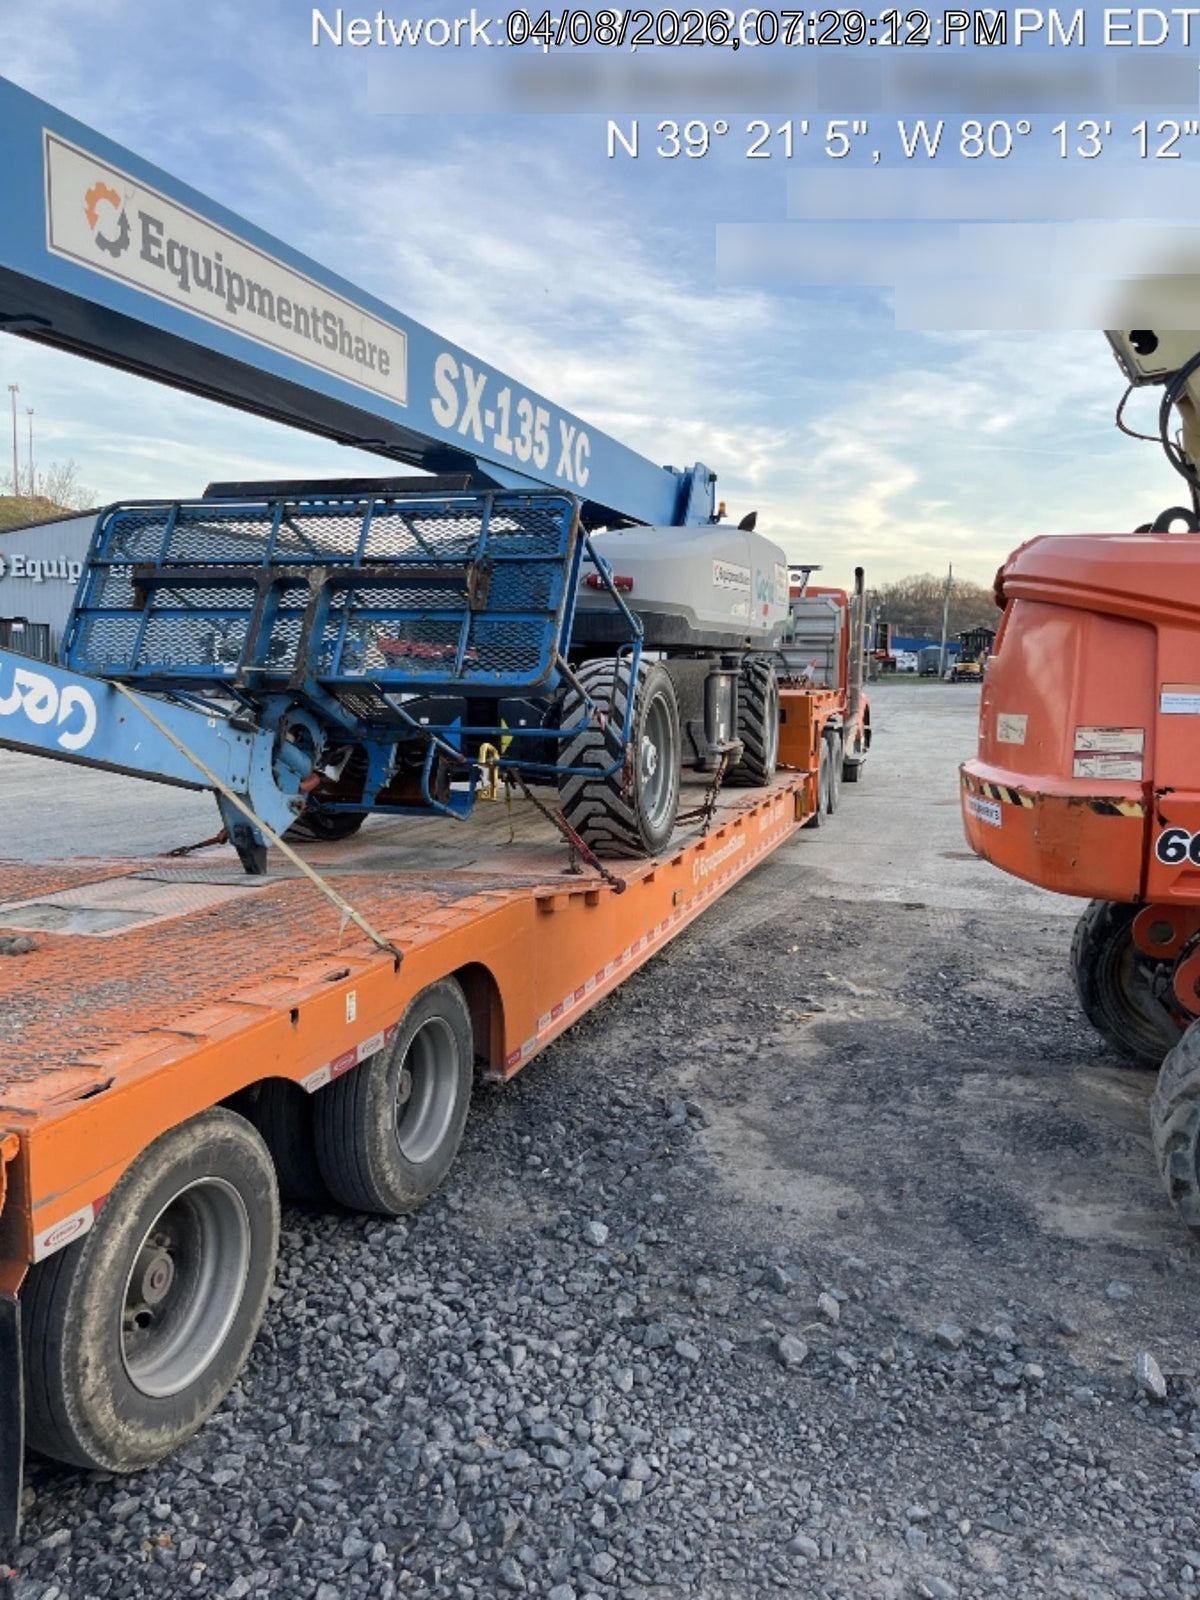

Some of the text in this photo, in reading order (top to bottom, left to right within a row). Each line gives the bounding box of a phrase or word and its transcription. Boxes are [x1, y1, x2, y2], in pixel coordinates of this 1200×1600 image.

[137, 209, 391, 376] EquipmentShare
[430, 352, 592, 488] SX-135 XC
